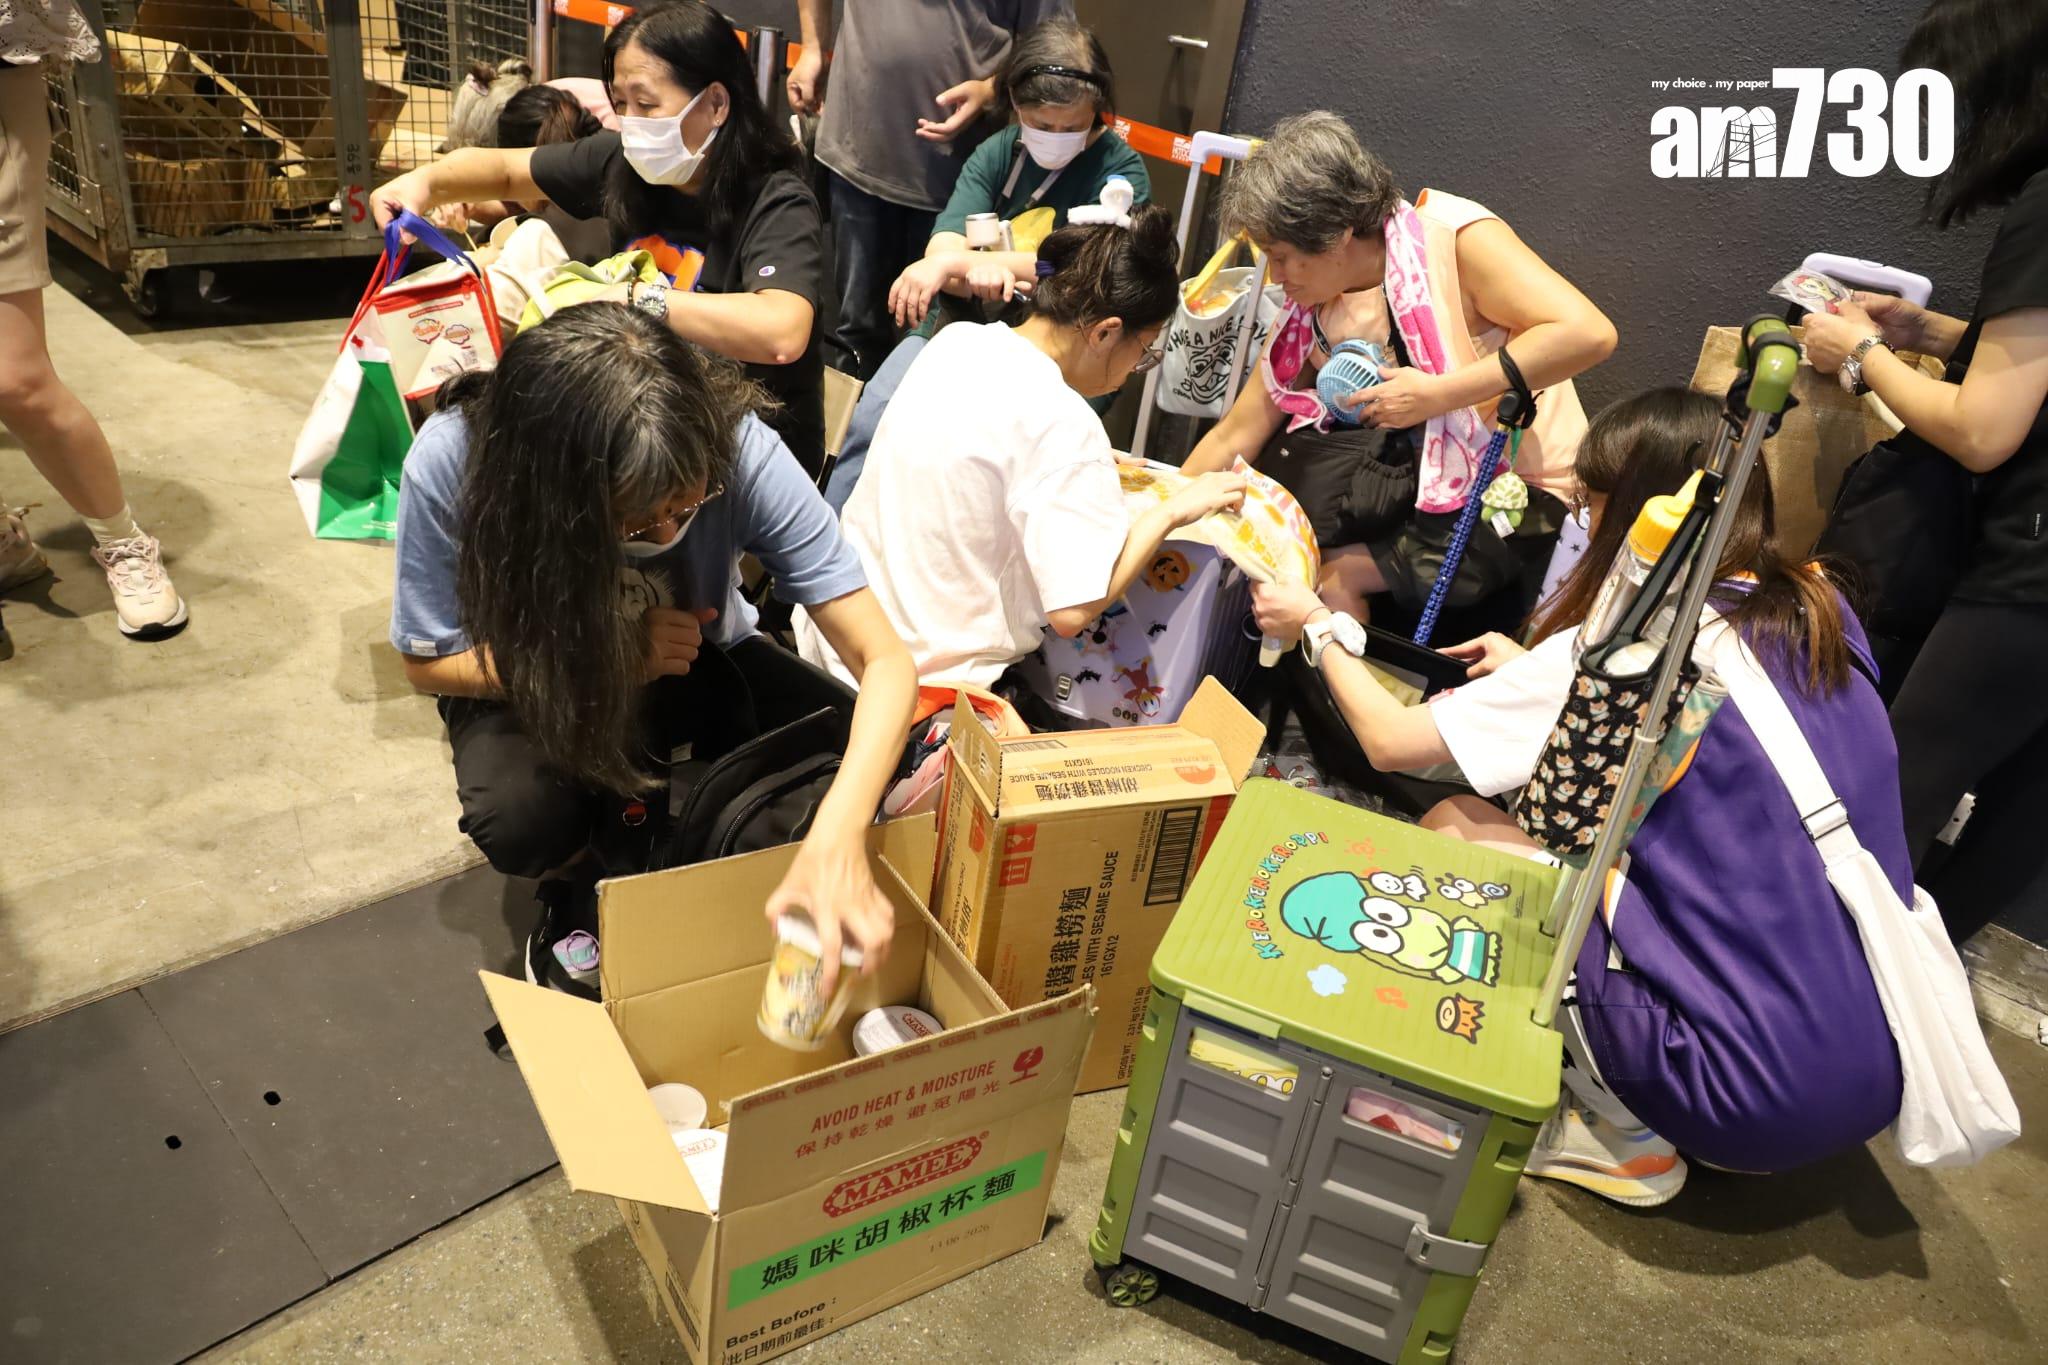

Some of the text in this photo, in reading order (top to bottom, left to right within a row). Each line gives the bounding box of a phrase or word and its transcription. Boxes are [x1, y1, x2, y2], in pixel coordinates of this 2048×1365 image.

[348, 184, 366, 223] 5
[1009, 773, 1035, 783] SAUCE
[1082, 851, 1119, 984] LES WITH SESAME SAUCE
[1243, 831, 1329, 960] KEROKEROKEROPPI
[1100, 934, 1120, 978] 161GX12
[811, 1061, 996, 1133] AVOID HEAT & MOISTURE
[842, 1147, 965, 1207] MAMEE
[760, 1169, 1017, 1291] 媽咪胡椒杯麵
[726, 1326, 766, 1349] Best
[770, 1302, 826, 1331] Before
